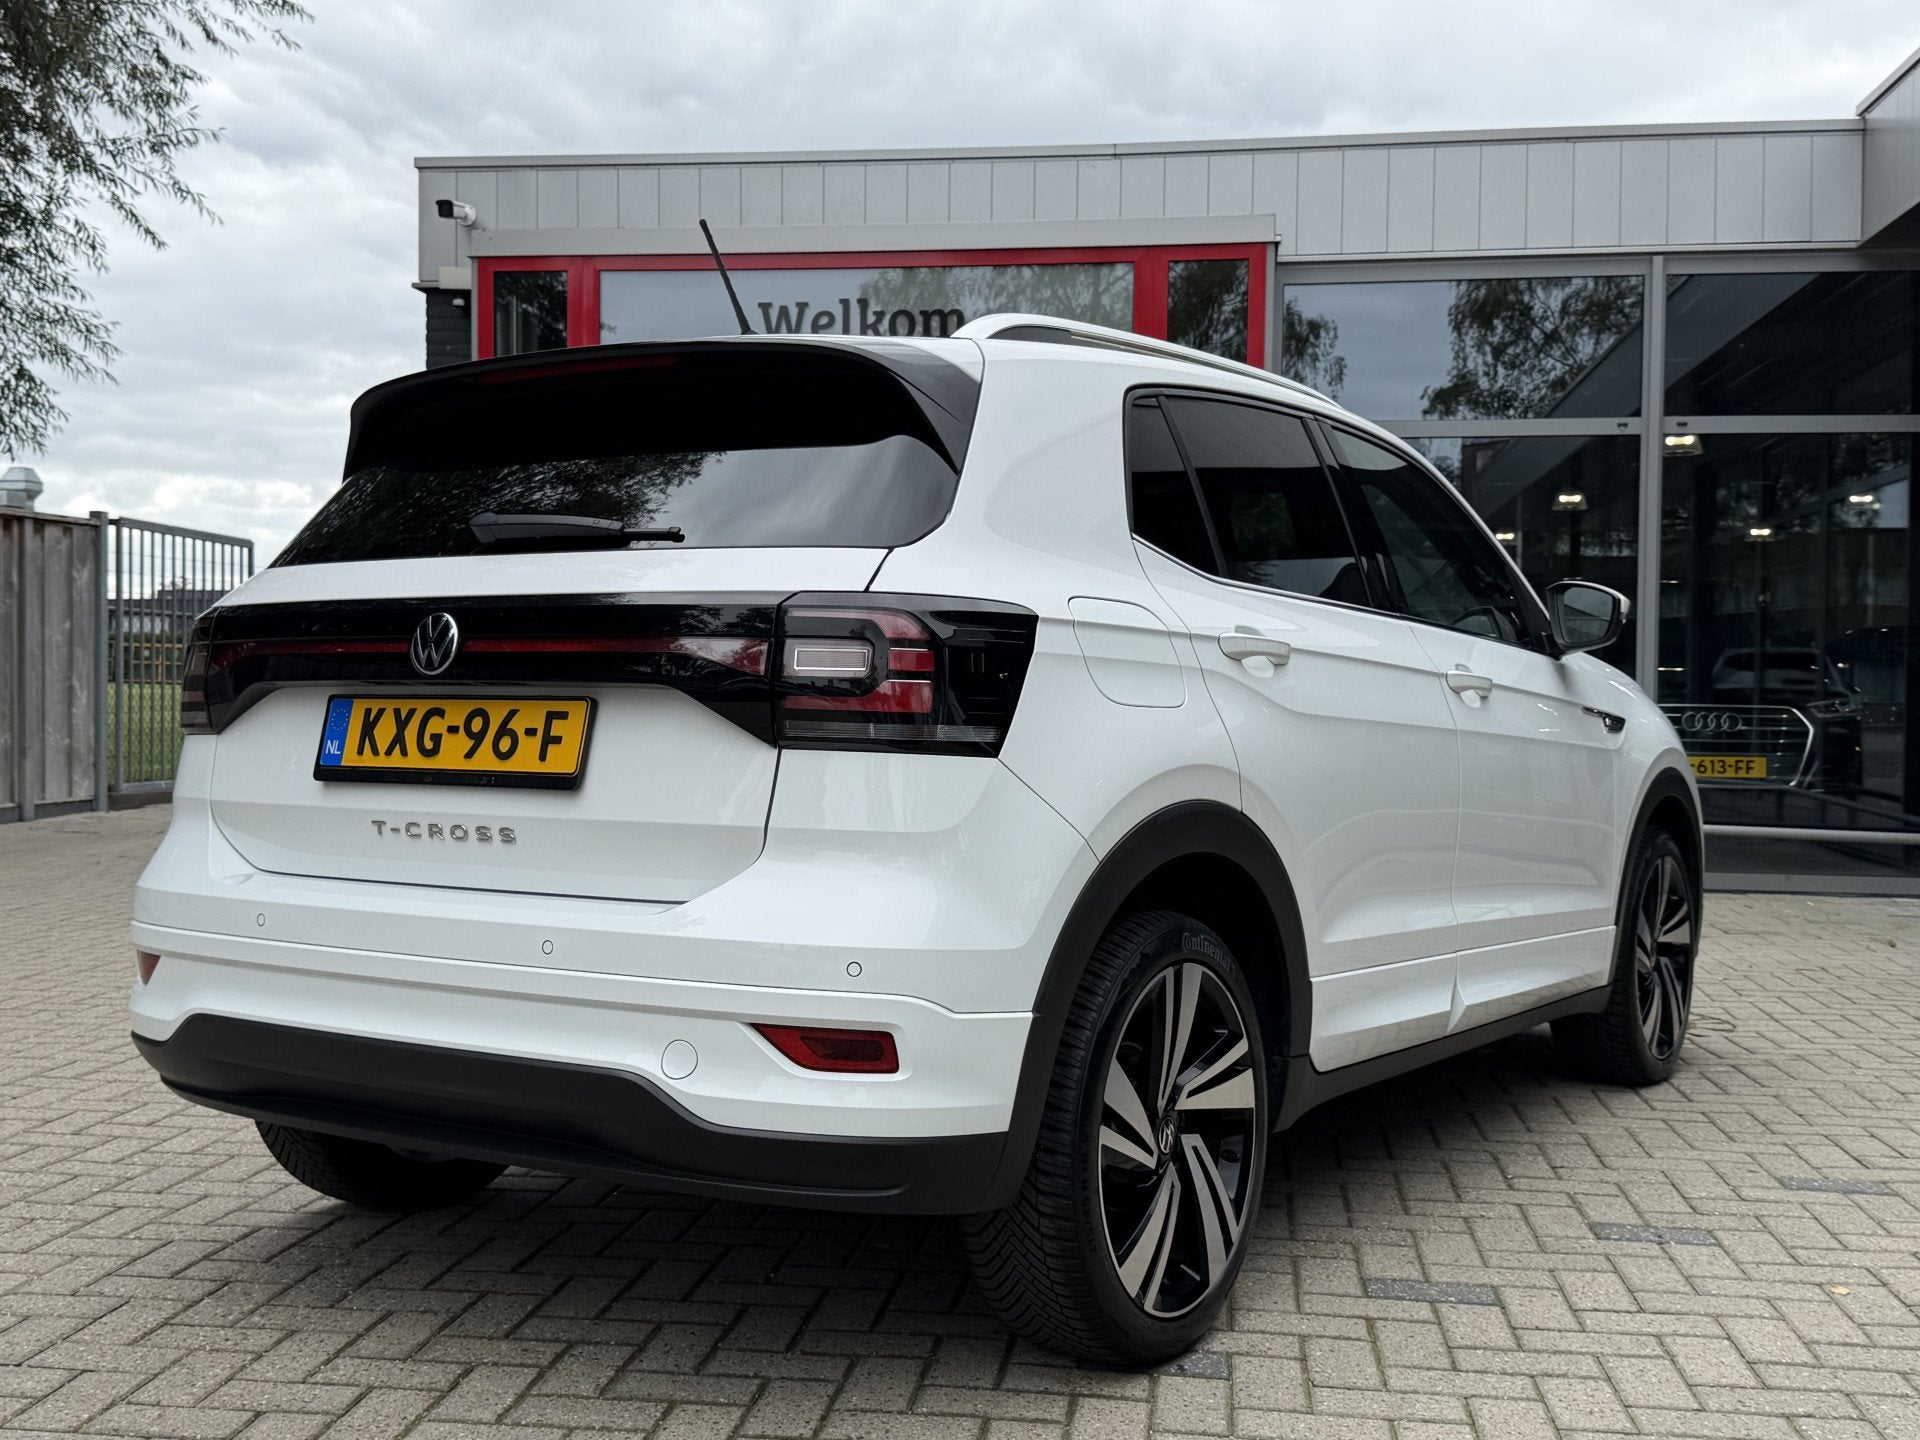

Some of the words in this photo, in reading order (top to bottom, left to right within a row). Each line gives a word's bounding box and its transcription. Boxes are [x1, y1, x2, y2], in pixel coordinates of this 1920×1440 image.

[757, 298, 965, 337] Welkom
[325, 738, 341, 755] NL
[356, 707, 570, 762] KXG-96-F
[371, 820, 517, 845] T-CROSS
